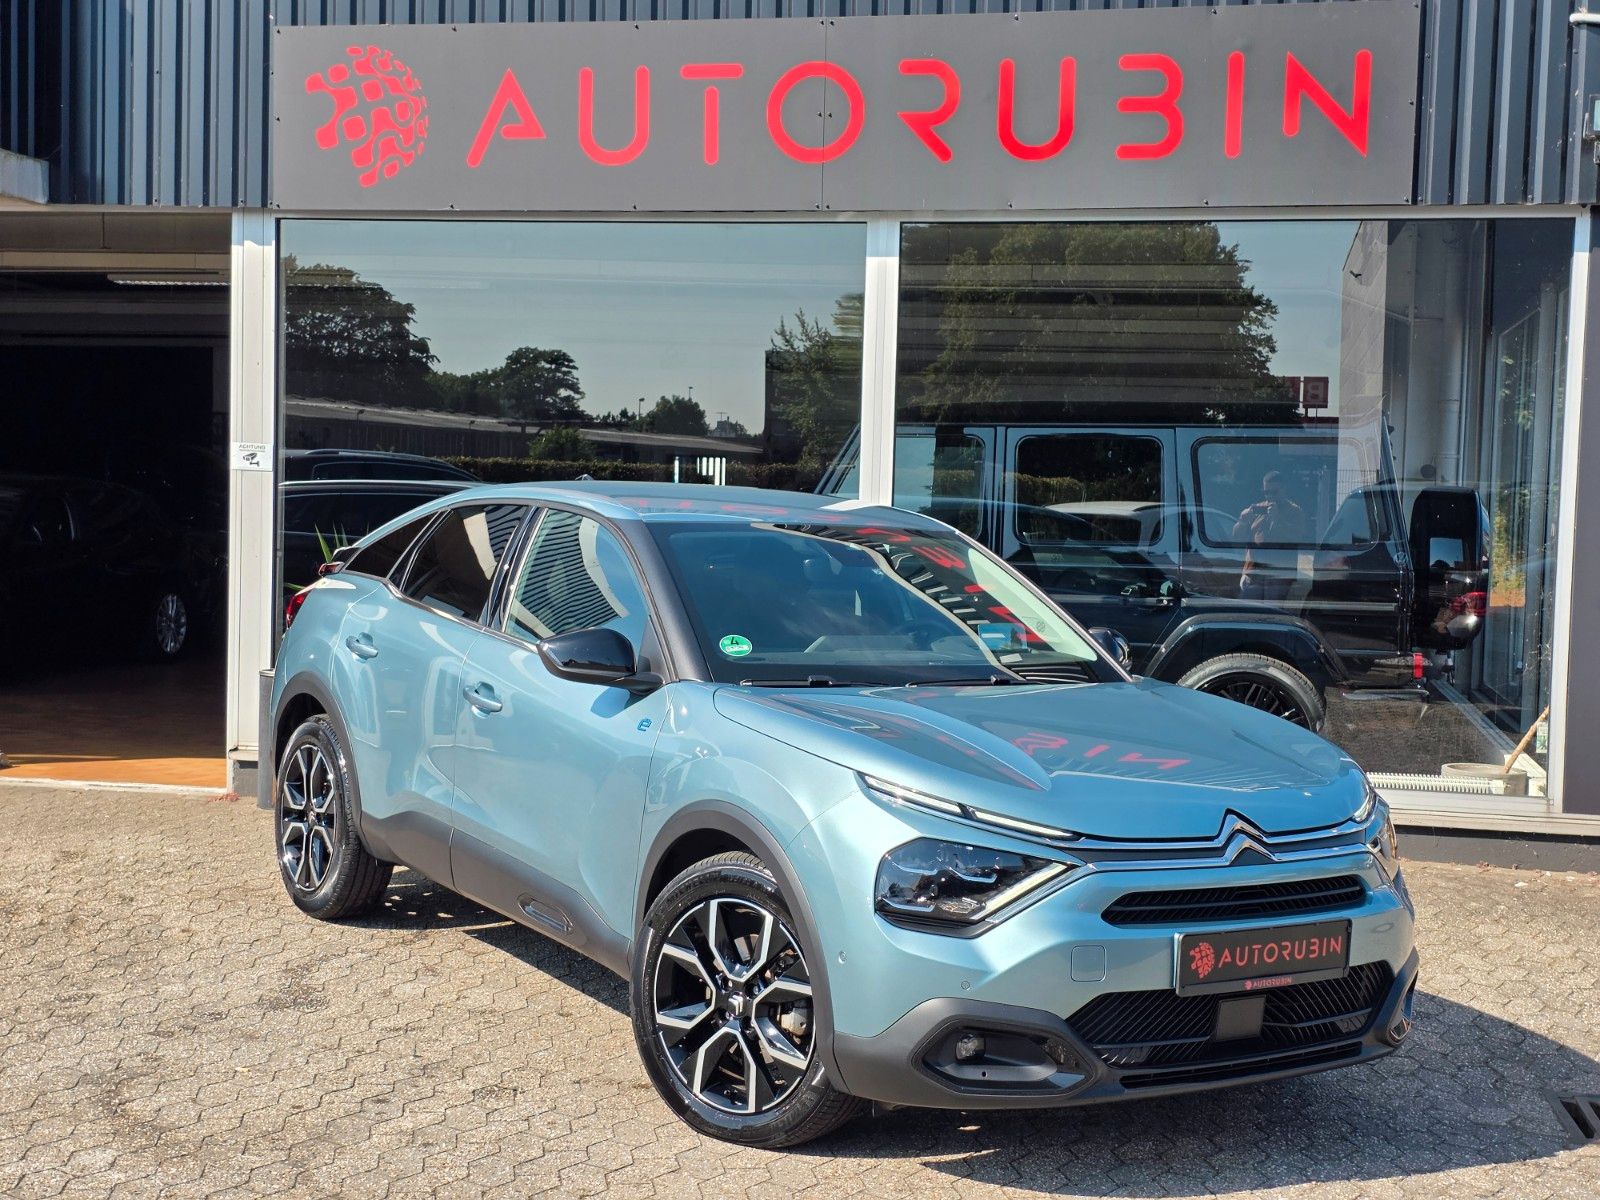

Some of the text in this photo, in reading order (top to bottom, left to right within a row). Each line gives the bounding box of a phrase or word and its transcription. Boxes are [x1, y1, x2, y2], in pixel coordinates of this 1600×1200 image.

[466, 49, 1373, 167] AUTORUBIN
[730, 636, 739, 645] 4
[1218, 935, 1343, 969] AUTORUBIN
[1253, 976, 1292, 988] AUTORUBIN
